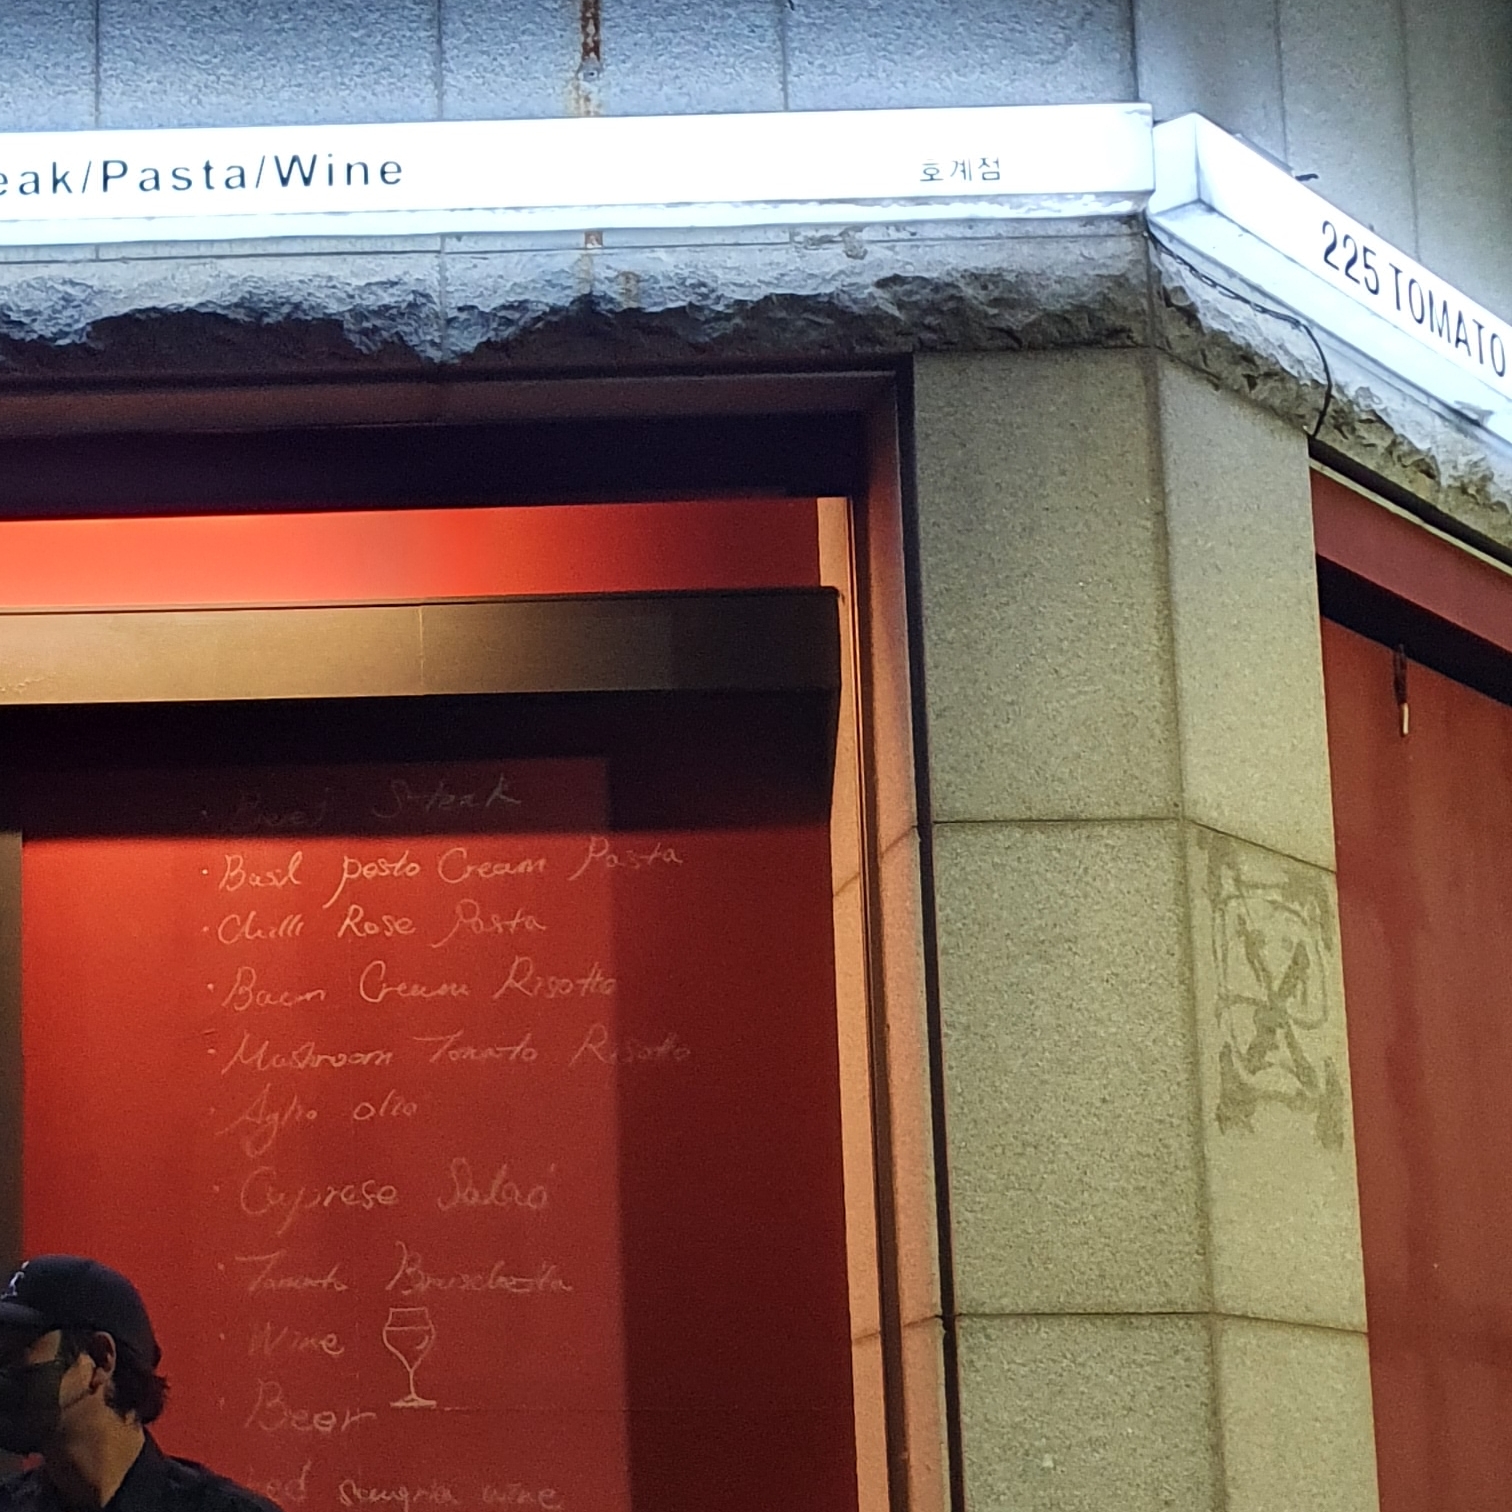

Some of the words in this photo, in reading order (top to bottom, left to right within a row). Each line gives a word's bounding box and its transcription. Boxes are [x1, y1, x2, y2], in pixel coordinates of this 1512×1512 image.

[918, 156, 1001, 182] 호계점
[1321, 219, 1380, 296] 225
[1388, 261, 1506, 378] TOMATO
[218, 850, 303, 892] Basil
[438, 846, 547, 884] Cream
[567, 836, 684, 882] Pasta
[337, 903, 417, 938] Rose
[431, 898, 547, 948] Pasta
[248, 1320, 346, 1358] Wine
[243, 1378, 379, 1432] Beer
